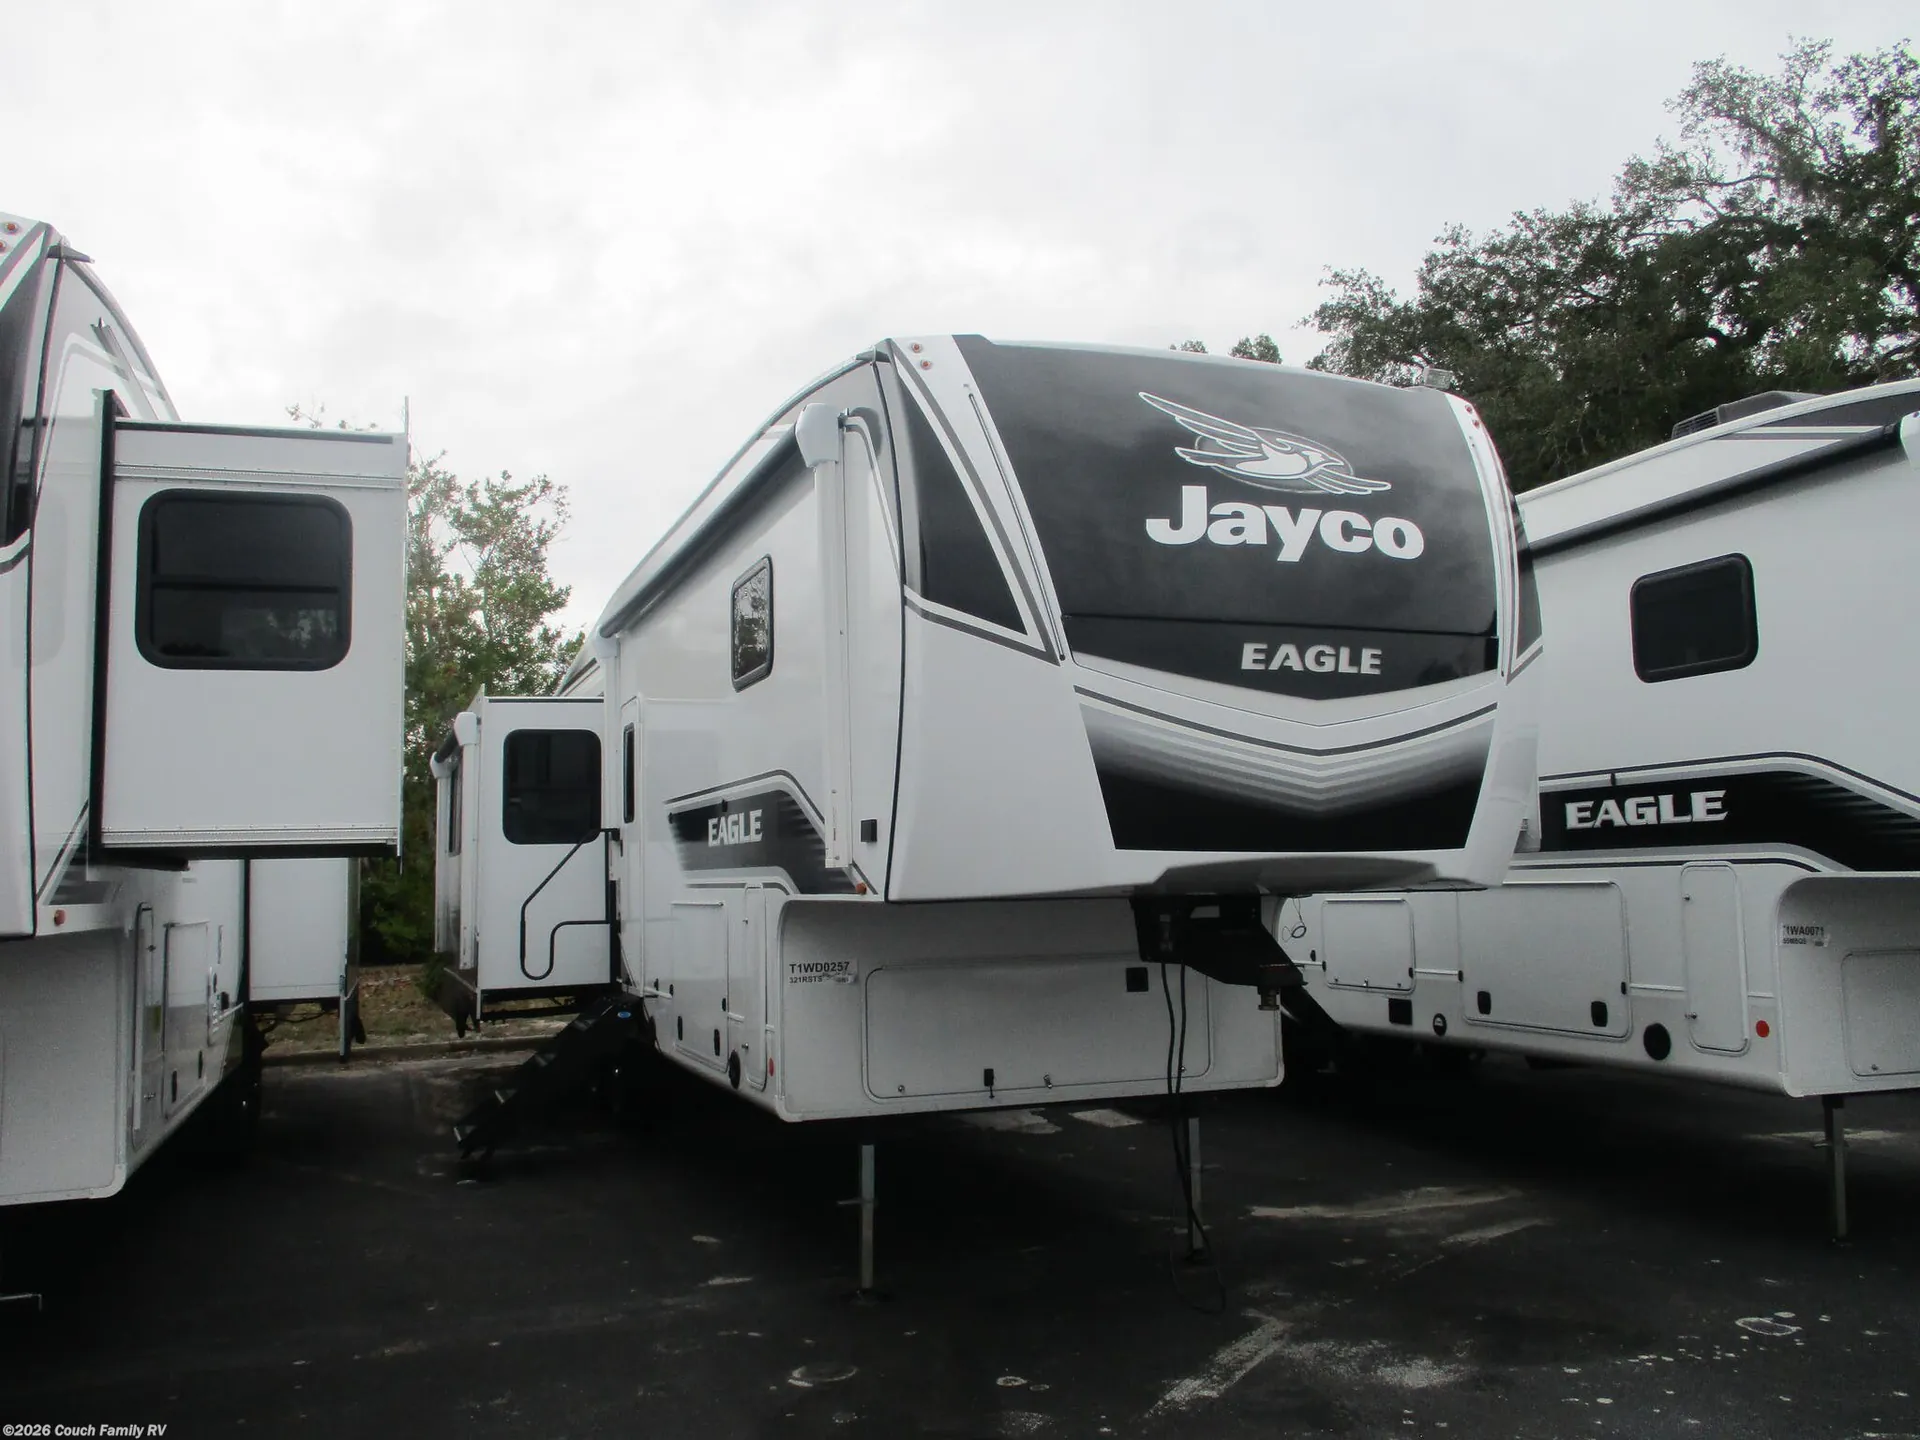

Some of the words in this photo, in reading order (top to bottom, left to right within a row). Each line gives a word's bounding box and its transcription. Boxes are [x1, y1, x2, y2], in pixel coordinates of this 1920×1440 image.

[1146, 485, 1424, 562] Jayco
[1241, 643, 1382, 674] EAGLE
[708, 809, 763, 847] EAGLE
[1565, 790, 1728, 830] EAGLE
[789, 961, 850, 973] T1WD0257
